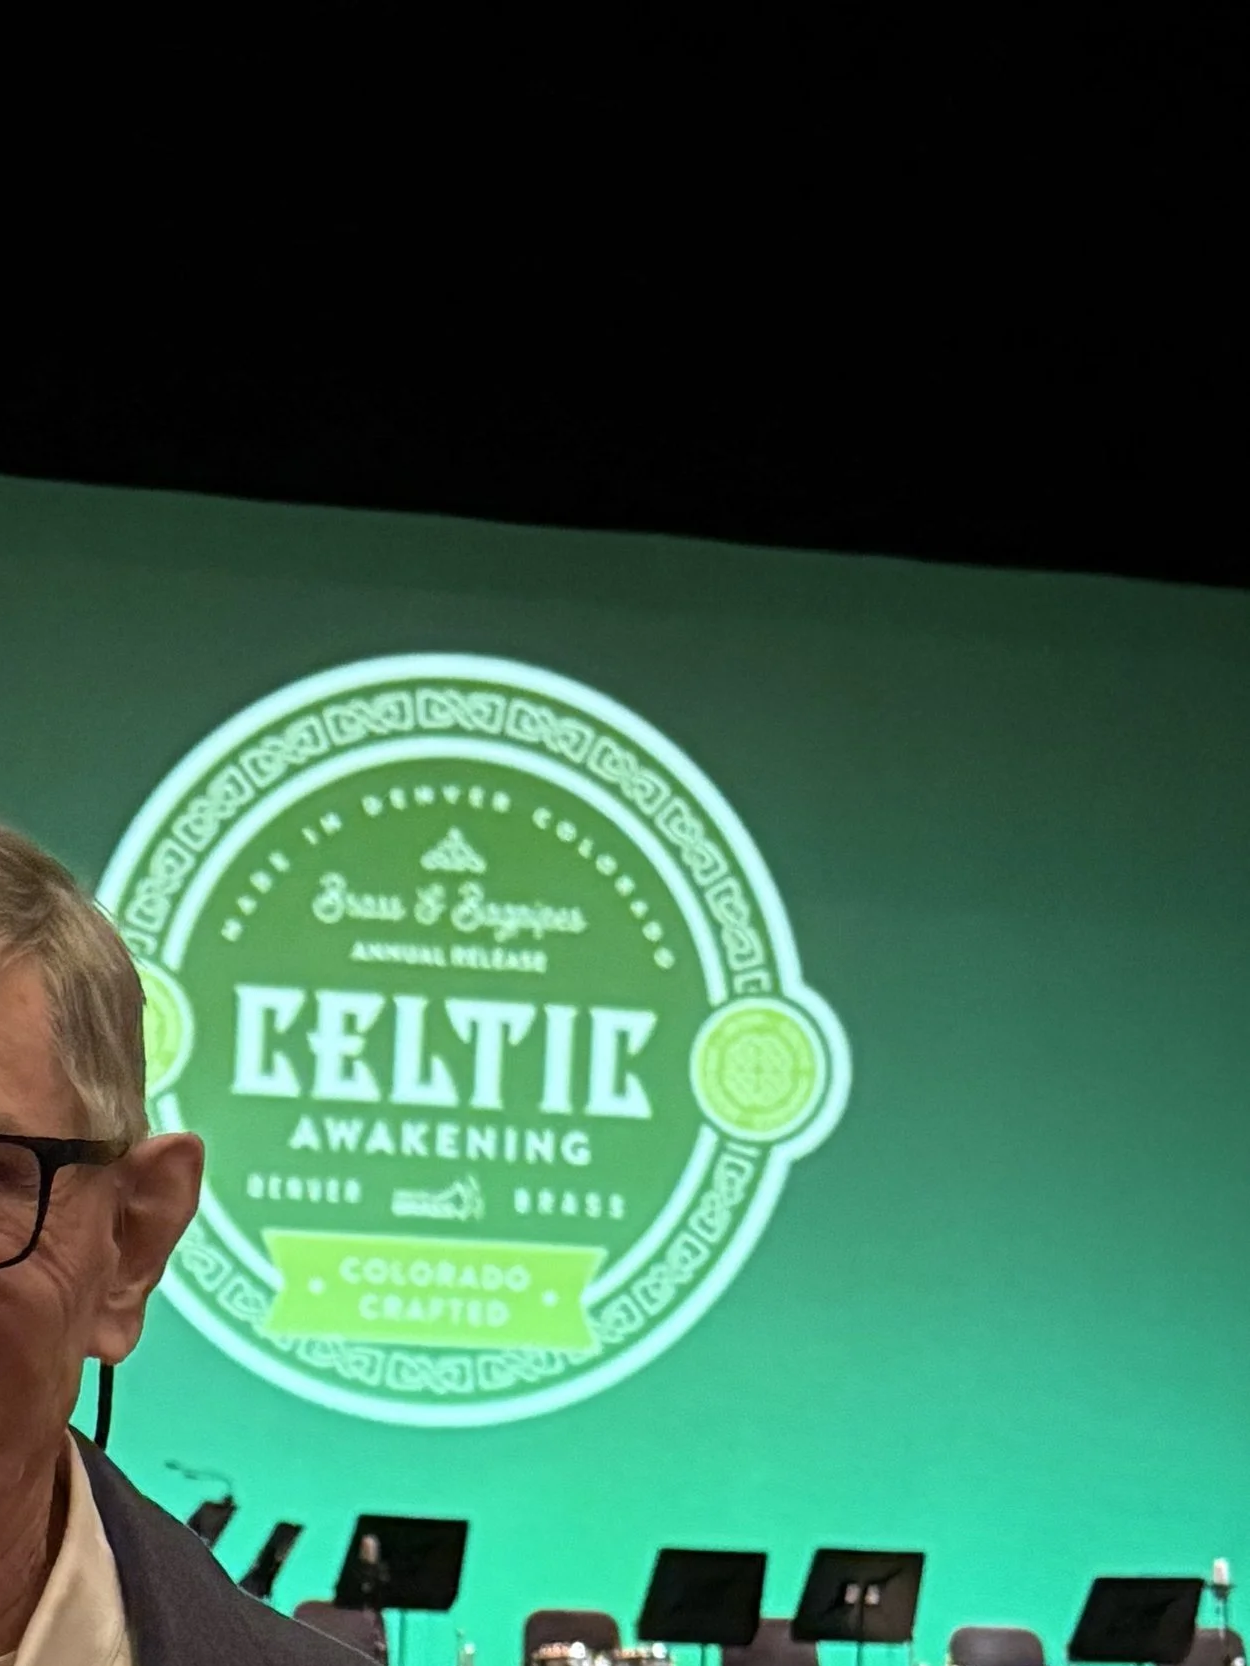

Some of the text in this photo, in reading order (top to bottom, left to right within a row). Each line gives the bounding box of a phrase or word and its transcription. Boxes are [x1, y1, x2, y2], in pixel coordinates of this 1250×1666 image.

[301, 811, 343, 846] IN
[361, 784, 510, 818] DENVER
[532, 805, 676, 970] COLORADO
[350, 940, 548, 973] ANNUAL RELEASE
[232, 984, 657, 1119] CELTIC
[288, 1114, 593, 1166] AWAKENING
[513, 1186, 625, 1221] BRASS
[339, 1255, 531, 1293] COLORADO
[358, 1292, 511, 1328] CRAFTED
